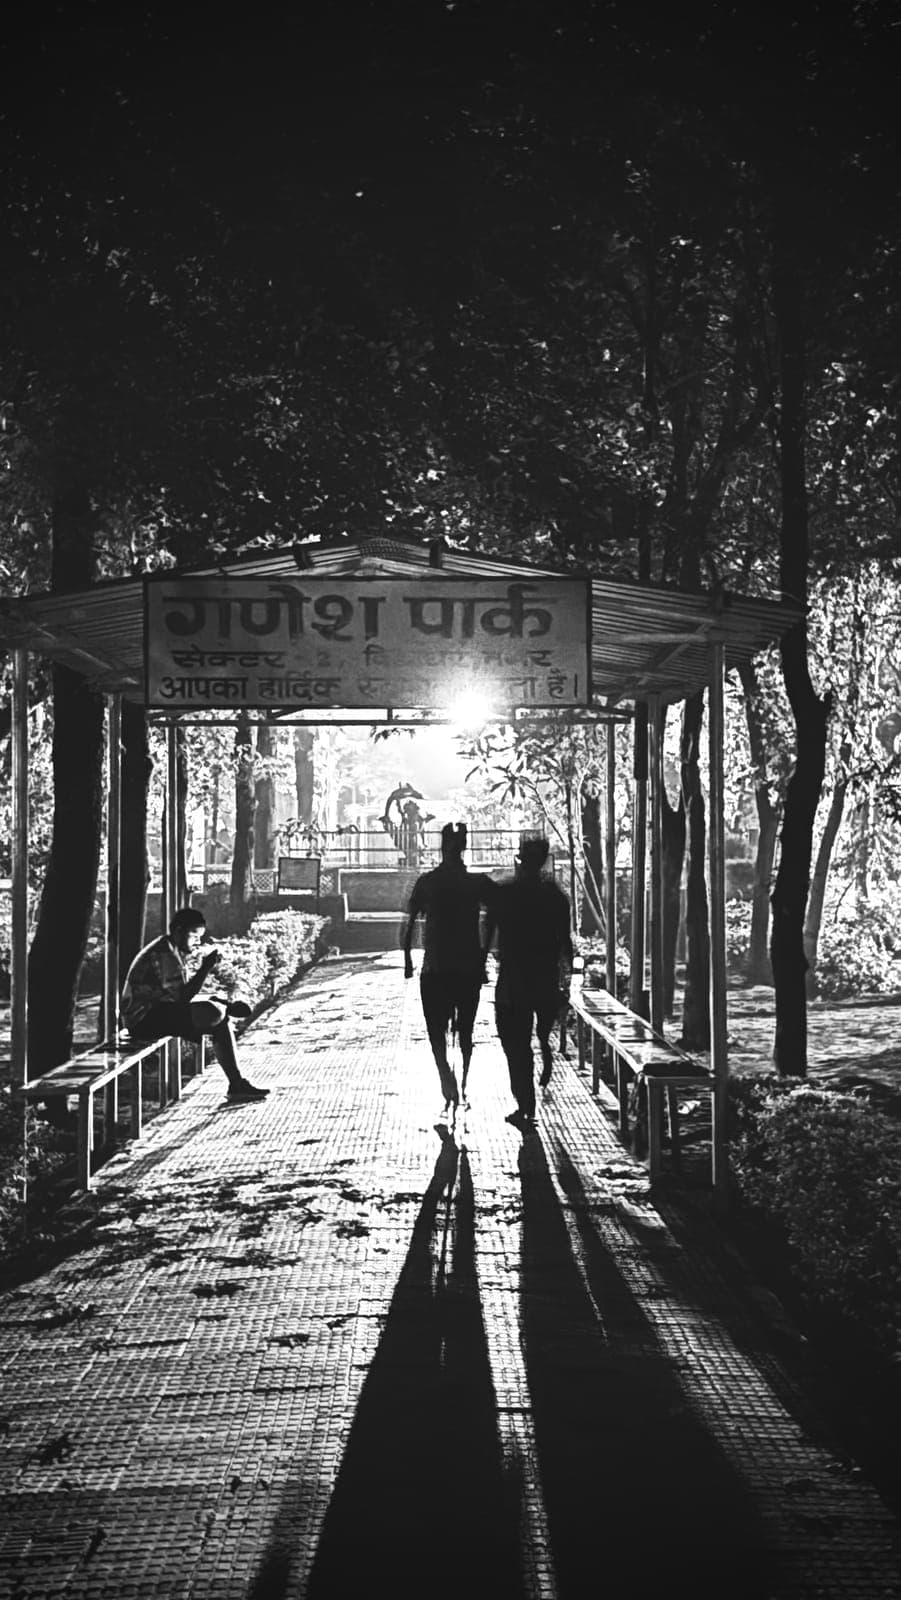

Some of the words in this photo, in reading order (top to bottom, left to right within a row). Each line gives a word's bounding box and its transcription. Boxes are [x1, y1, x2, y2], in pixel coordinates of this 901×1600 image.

[161, 583, 387, 642] गणेश
[402, 583, 558, 641] पार्क
[168, 644, 286, 670] सेक्टर
[158, 675, 249, 700] आपका
[257, 670, 341, 702] हार्दिक
